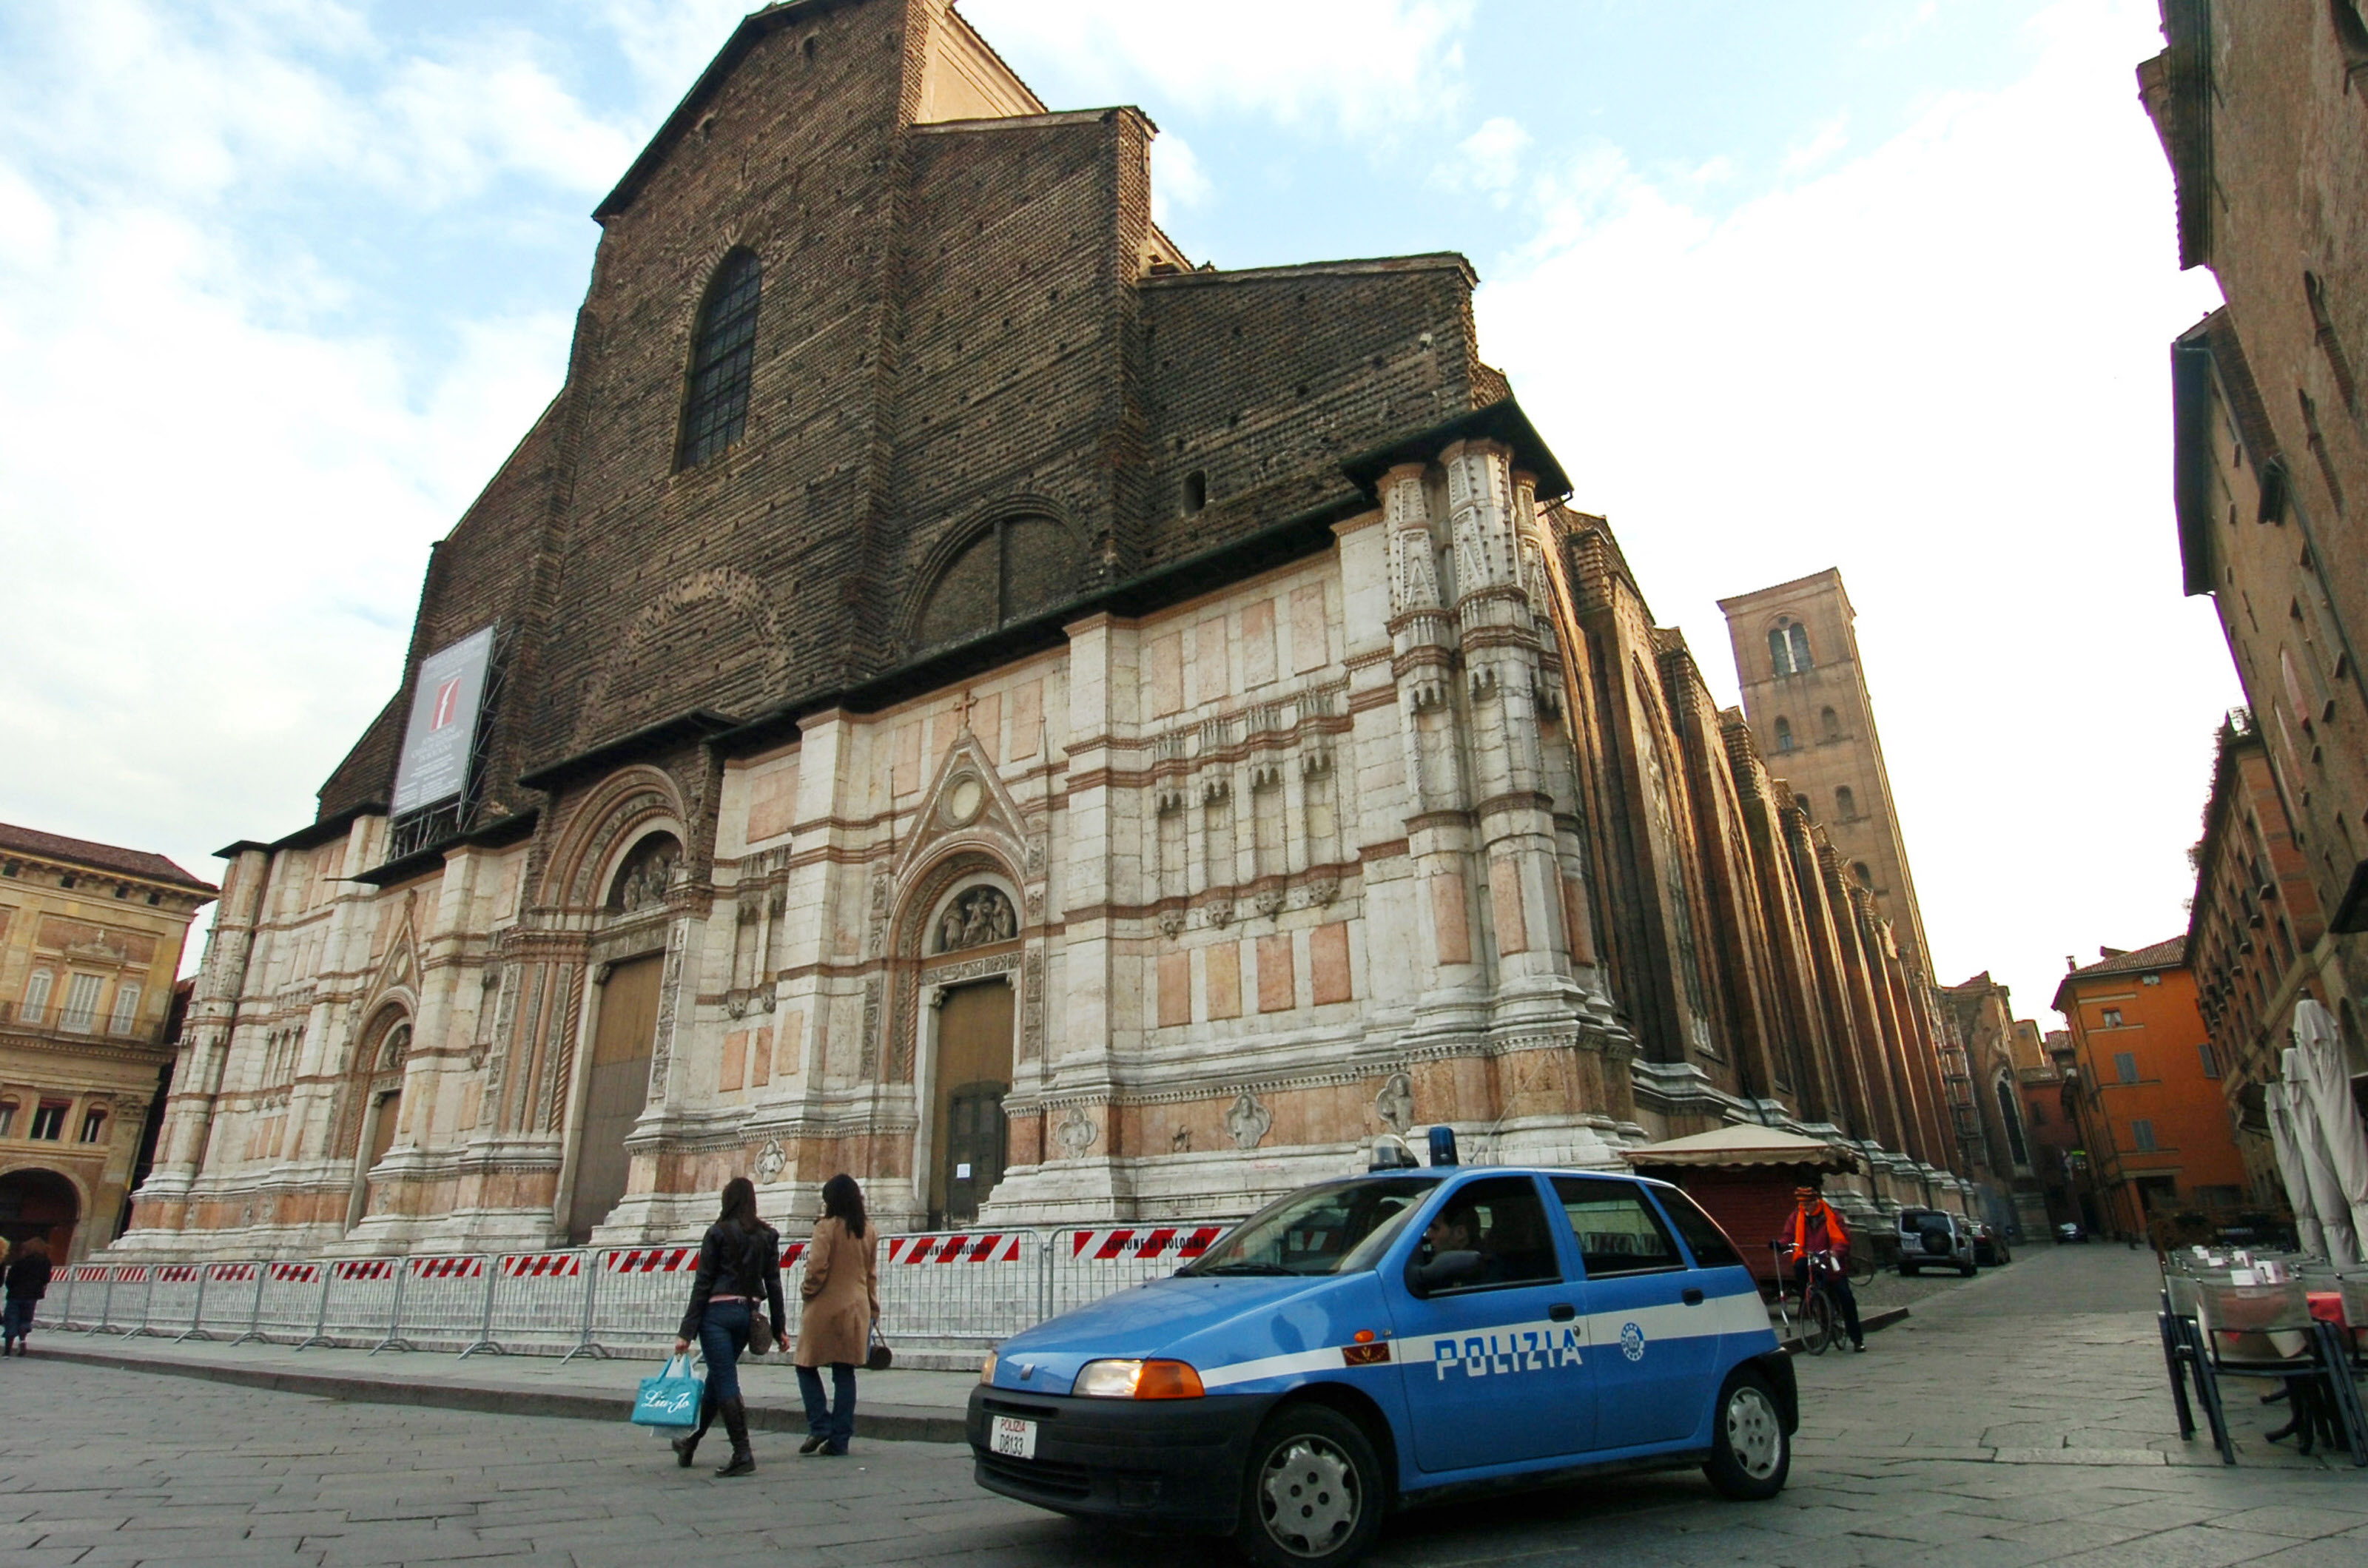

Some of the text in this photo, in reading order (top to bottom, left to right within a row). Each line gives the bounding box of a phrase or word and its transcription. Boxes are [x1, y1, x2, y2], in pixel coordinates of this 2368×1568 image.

[1106, 1236, 1207, 1251] COMUNE DI BOLOGNA
[1434, 1329, 1583, 1381] POLIZIA
[1000, 1419, 1026, 1433] POLIZIA
